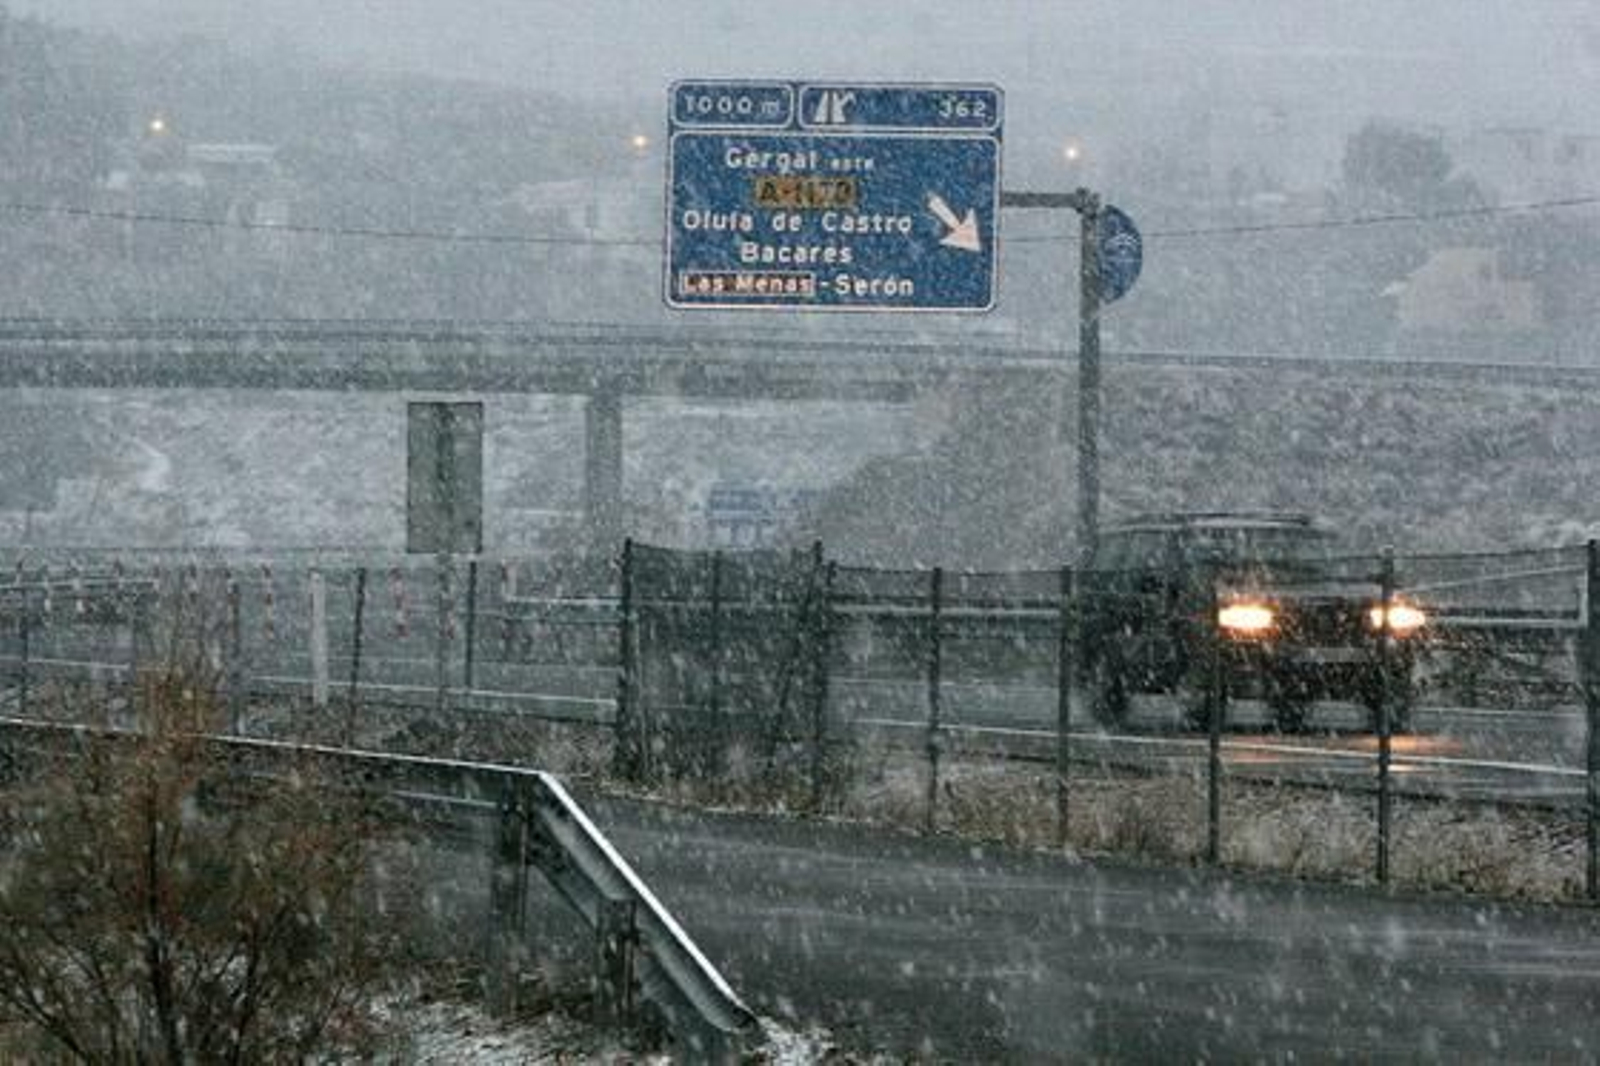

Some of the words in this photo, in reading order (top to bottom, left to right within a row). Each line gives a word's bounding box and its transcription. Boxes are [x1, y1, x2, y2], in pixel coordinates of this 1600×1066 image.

[684, 95, 752, 114] 1000
[939, 99, 986, 118] 362
[772, 212, 802, 231] de
[821, 212, 912, 233] Castro
[741, 241, 853, 263] Bacares
[684, 274, 724, 293] Las
[735, 273, 812, 293] Menas
